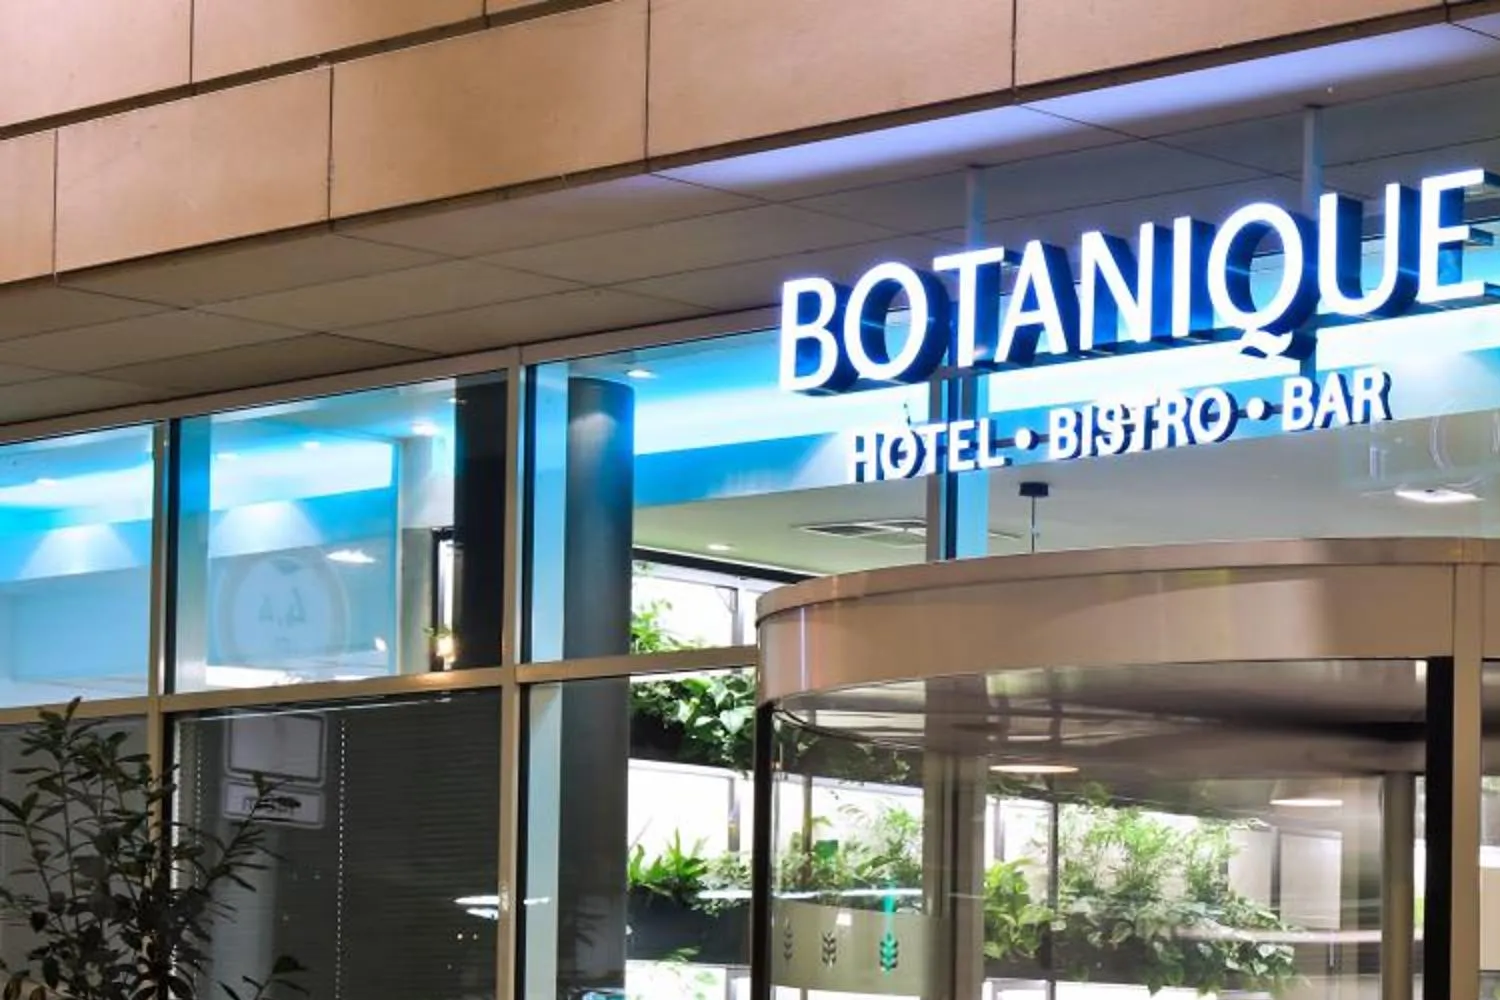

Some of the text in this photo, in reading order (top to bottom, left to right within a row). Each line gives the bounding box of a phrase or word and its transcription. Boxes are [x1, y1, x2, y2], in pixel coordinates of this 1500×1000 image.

[777, 168, 1496, 393] BOTANIQUE
[1048, 386, 1234, 461] BISTRO
[1281, 364, 1388, 431] BAR
